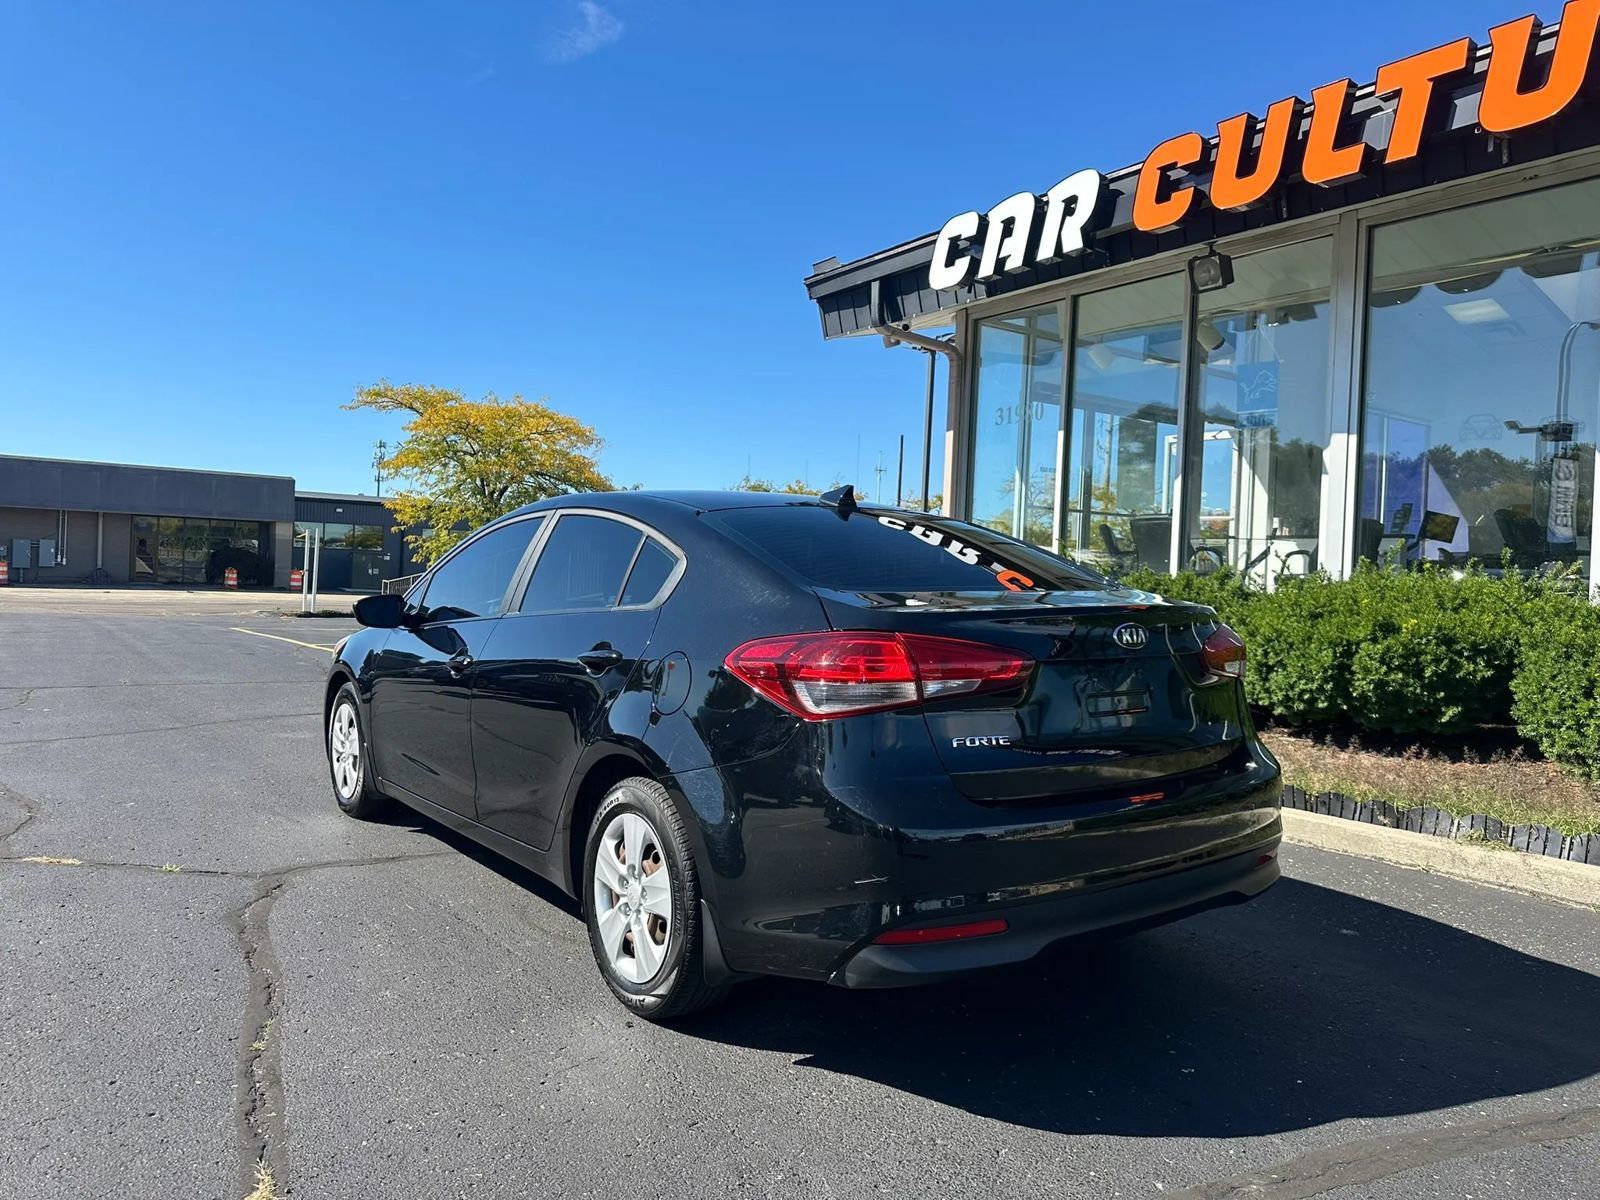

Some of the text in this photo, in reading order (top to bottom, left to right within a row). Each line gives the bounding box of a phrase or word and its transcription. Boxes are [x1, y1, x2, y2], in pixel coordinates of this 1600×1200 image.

[929, 0, 1600, 291] CAR CULTU
[951, 735, 1011, 748] FORTE
